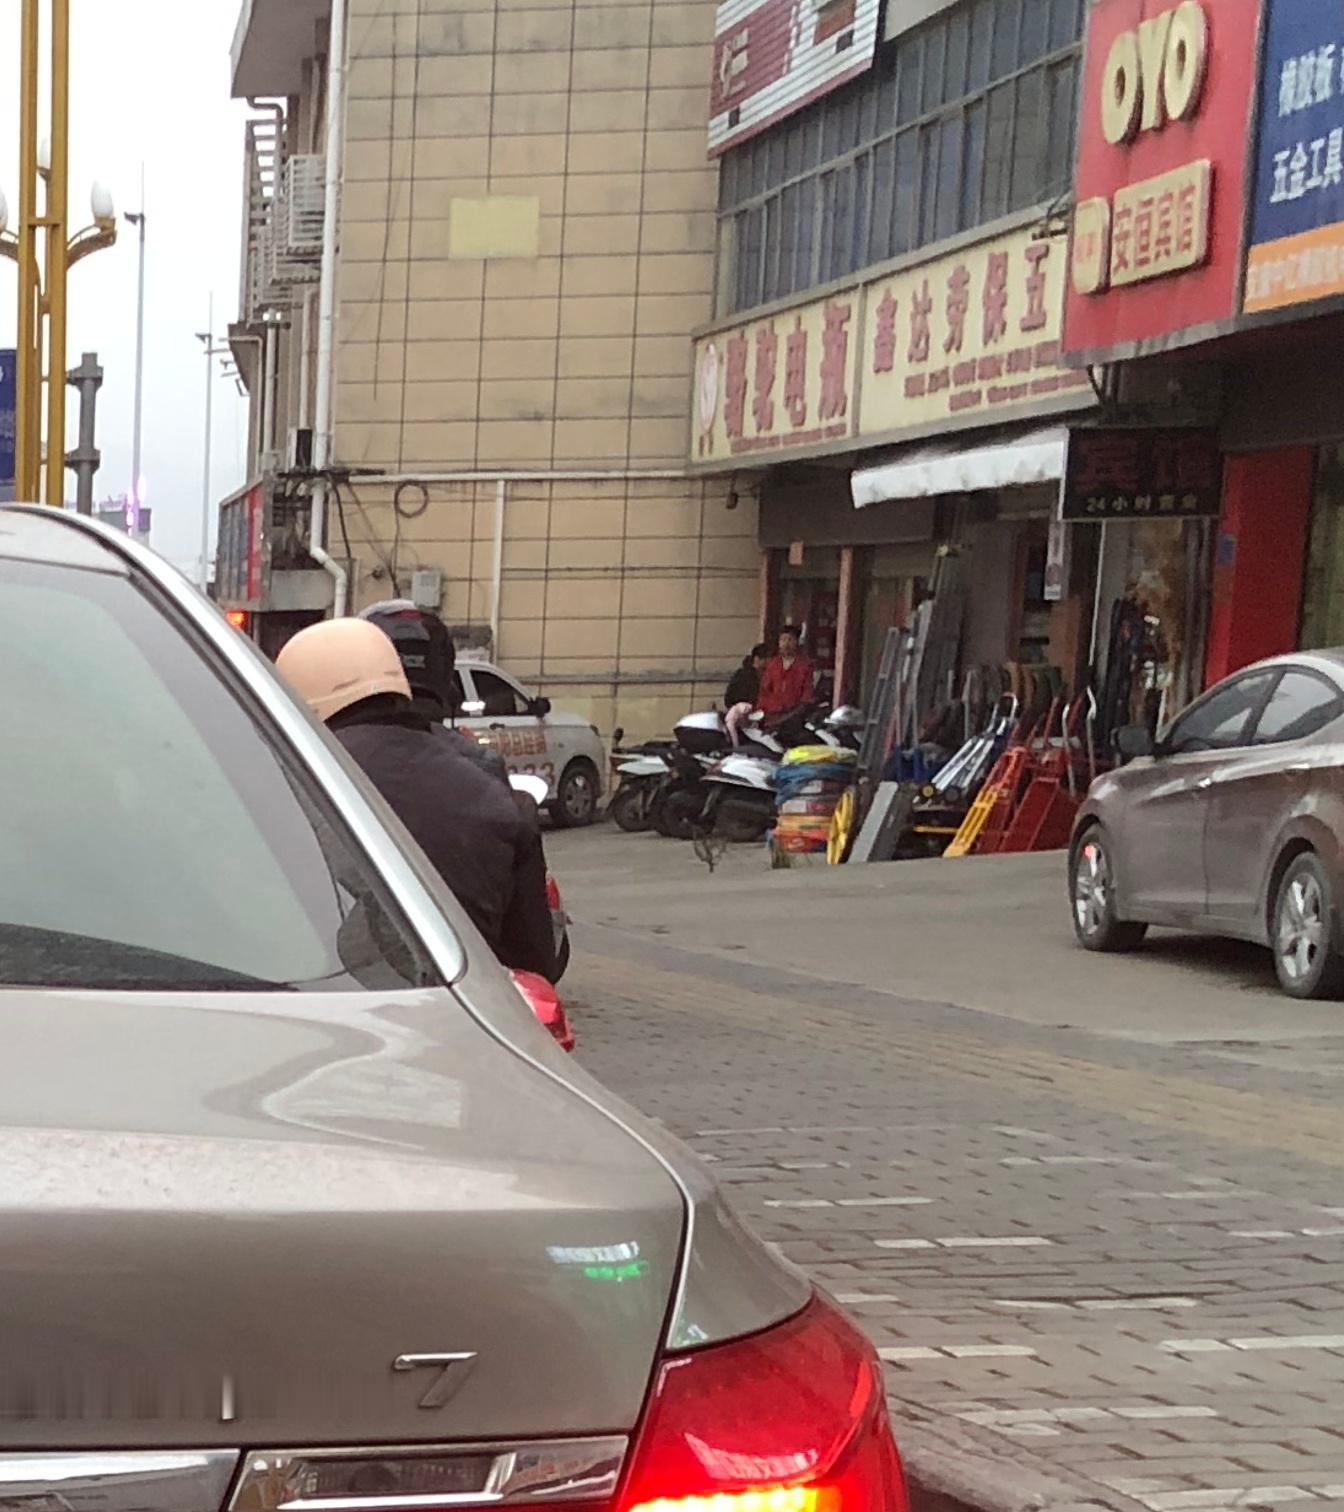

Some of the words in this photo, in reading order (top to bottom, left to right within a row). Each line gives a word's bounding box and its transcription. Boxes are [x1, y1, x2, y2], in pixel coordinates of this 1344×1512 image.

[1101, 0, 1207, 144] OYO
[1270, 127, 1343, 203] 五金工具
